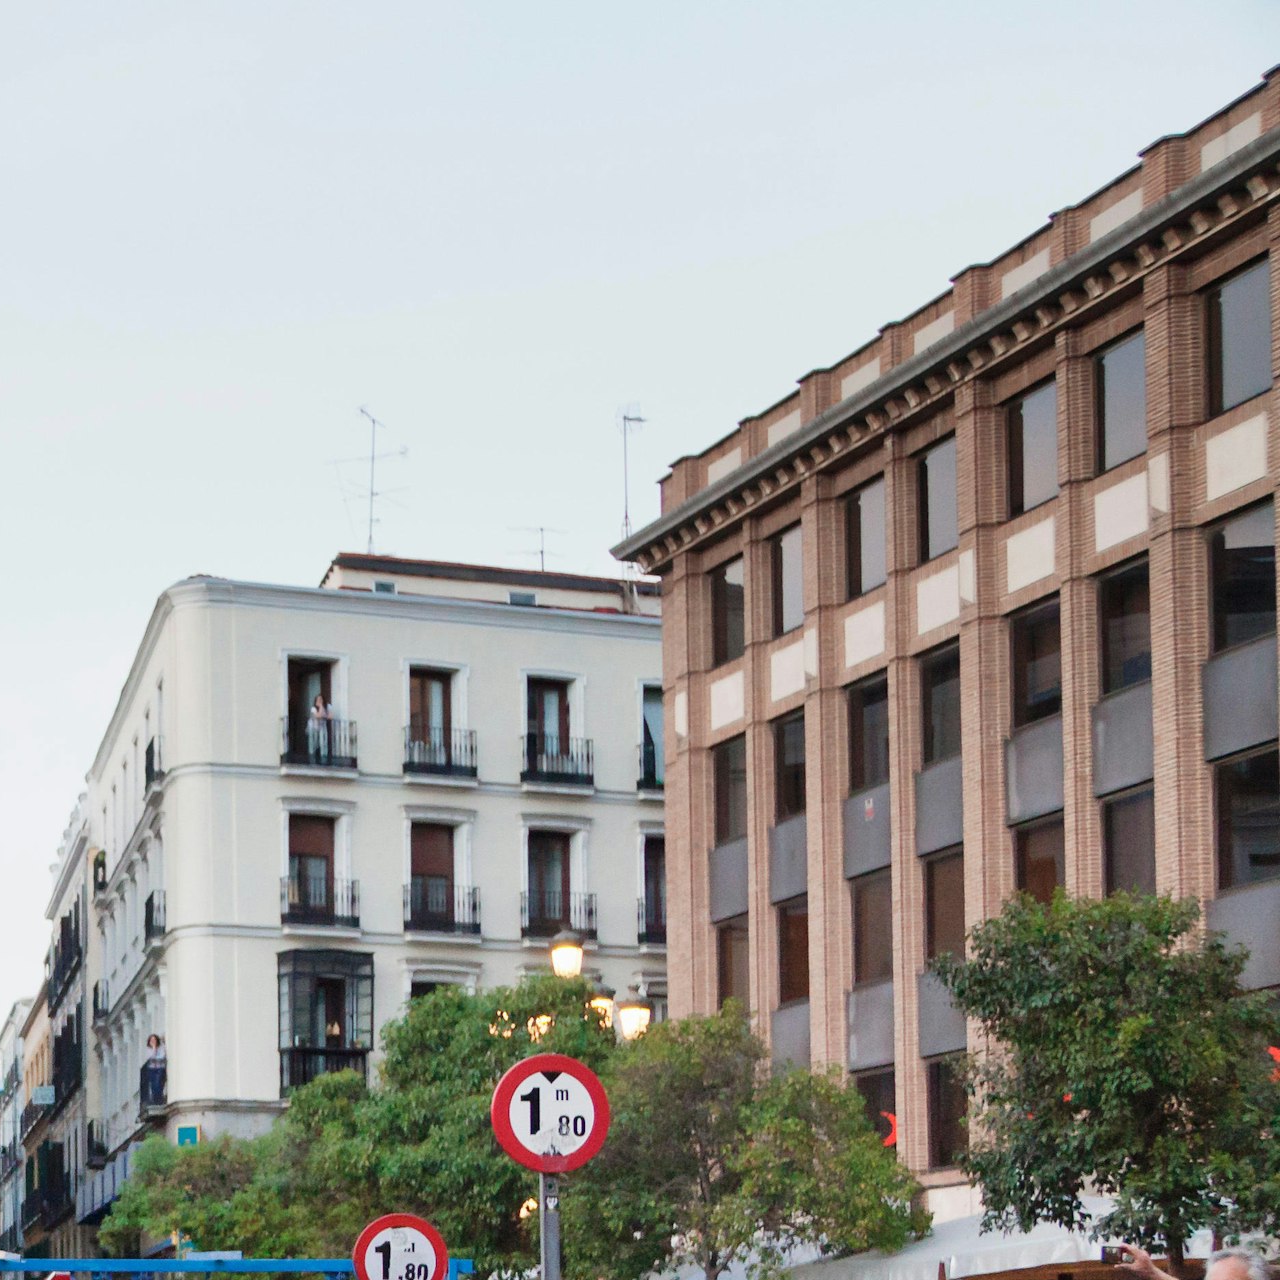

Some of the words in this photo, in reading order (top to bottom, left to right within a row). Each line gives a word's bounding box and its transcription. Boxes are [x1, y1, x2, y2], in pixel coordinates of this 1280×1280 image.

[556, 1089, 569, 1101] m
[521, 1087, 540, 1135] 1
[558, 1115, 586, 1137] 80
[375, 1241, 391, 1280] 1
